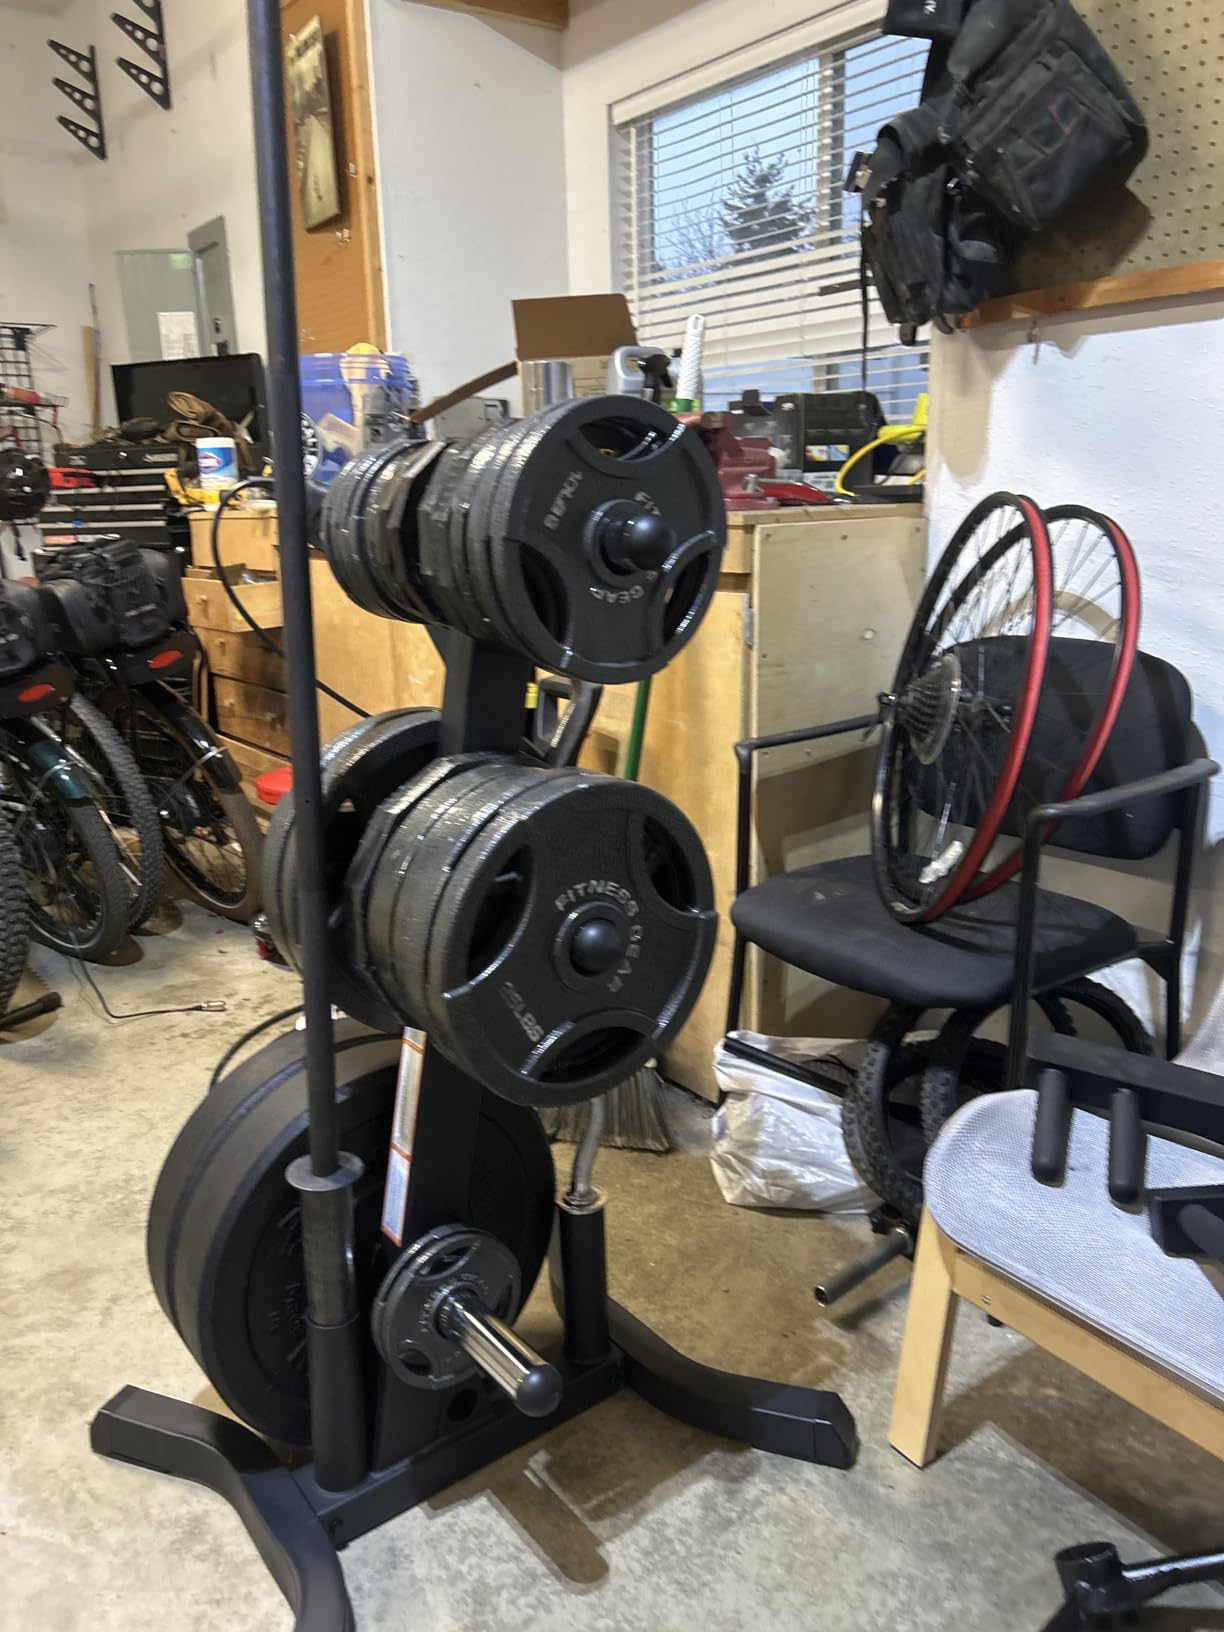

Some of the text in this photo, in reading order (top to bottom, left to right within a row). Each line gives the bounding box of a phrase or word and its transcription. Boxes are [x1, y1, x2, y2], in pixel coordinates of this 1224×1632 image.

[590, 585, 643, 604] GEAR
[555, 880, 643, 993] FITNESS GEAR
